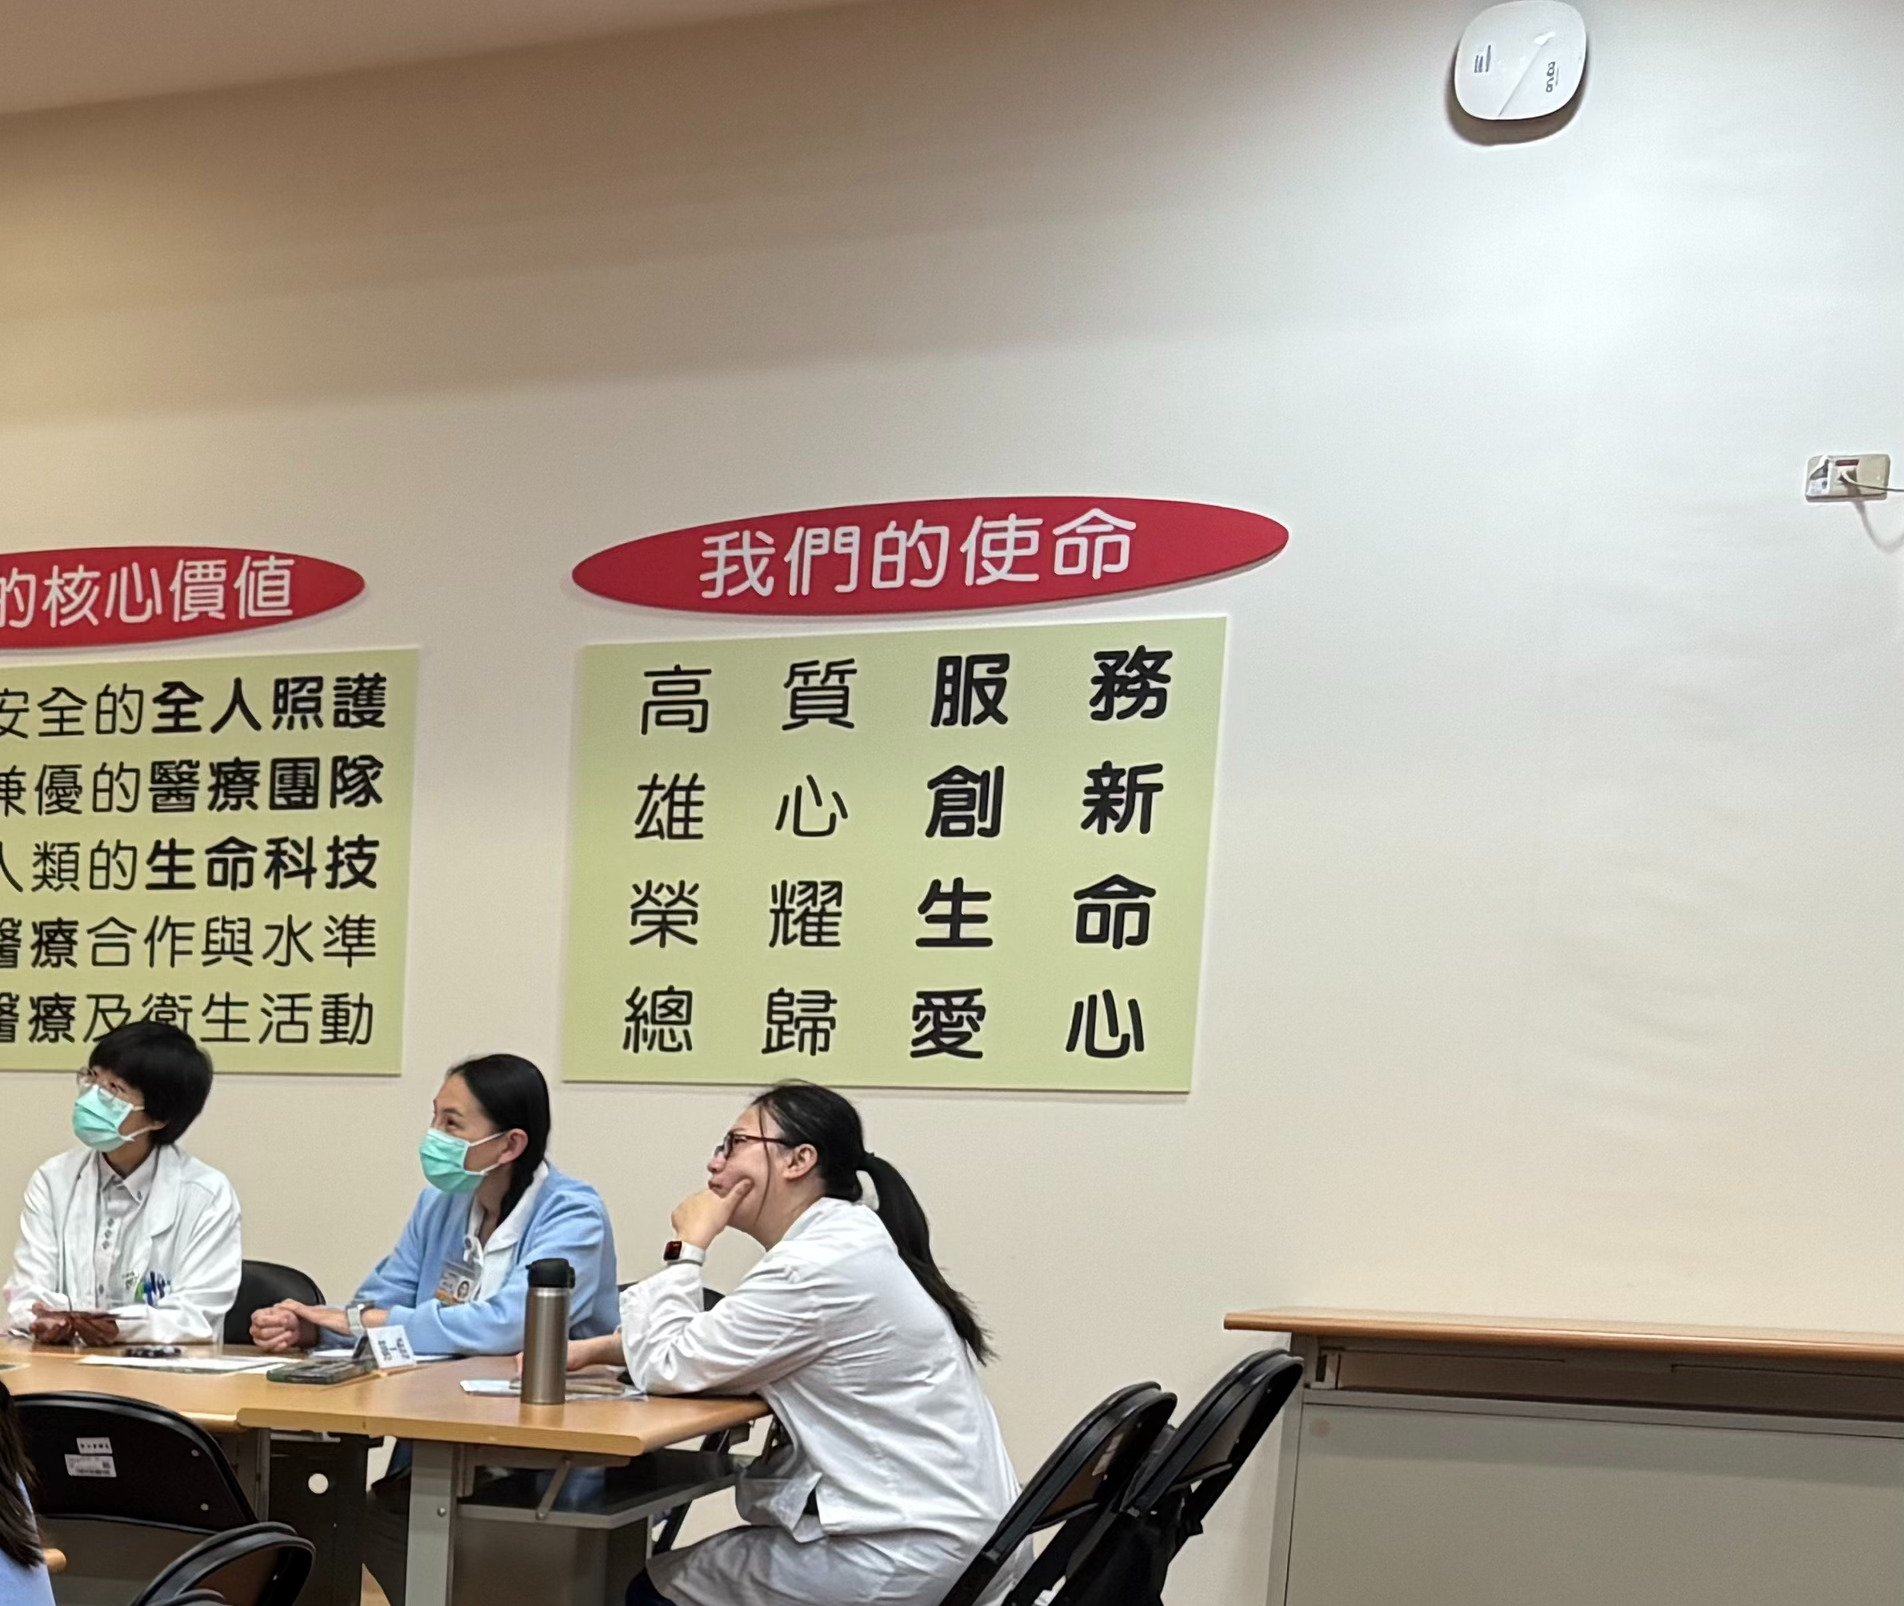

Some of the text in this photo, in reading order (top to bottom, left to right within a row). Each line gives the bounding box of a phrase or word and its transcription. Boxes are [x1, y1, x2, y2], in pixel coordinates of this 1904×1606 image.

[699, 507, 1138, 602] 我們的使命
[640, 644, 1174, 736] 高質服務
[633, 760, 1164, 841] 雄心創新
[628, 873, 1158, 951] 榮耀生命
[622, 984, 1146, 1060] 總歸愛心
